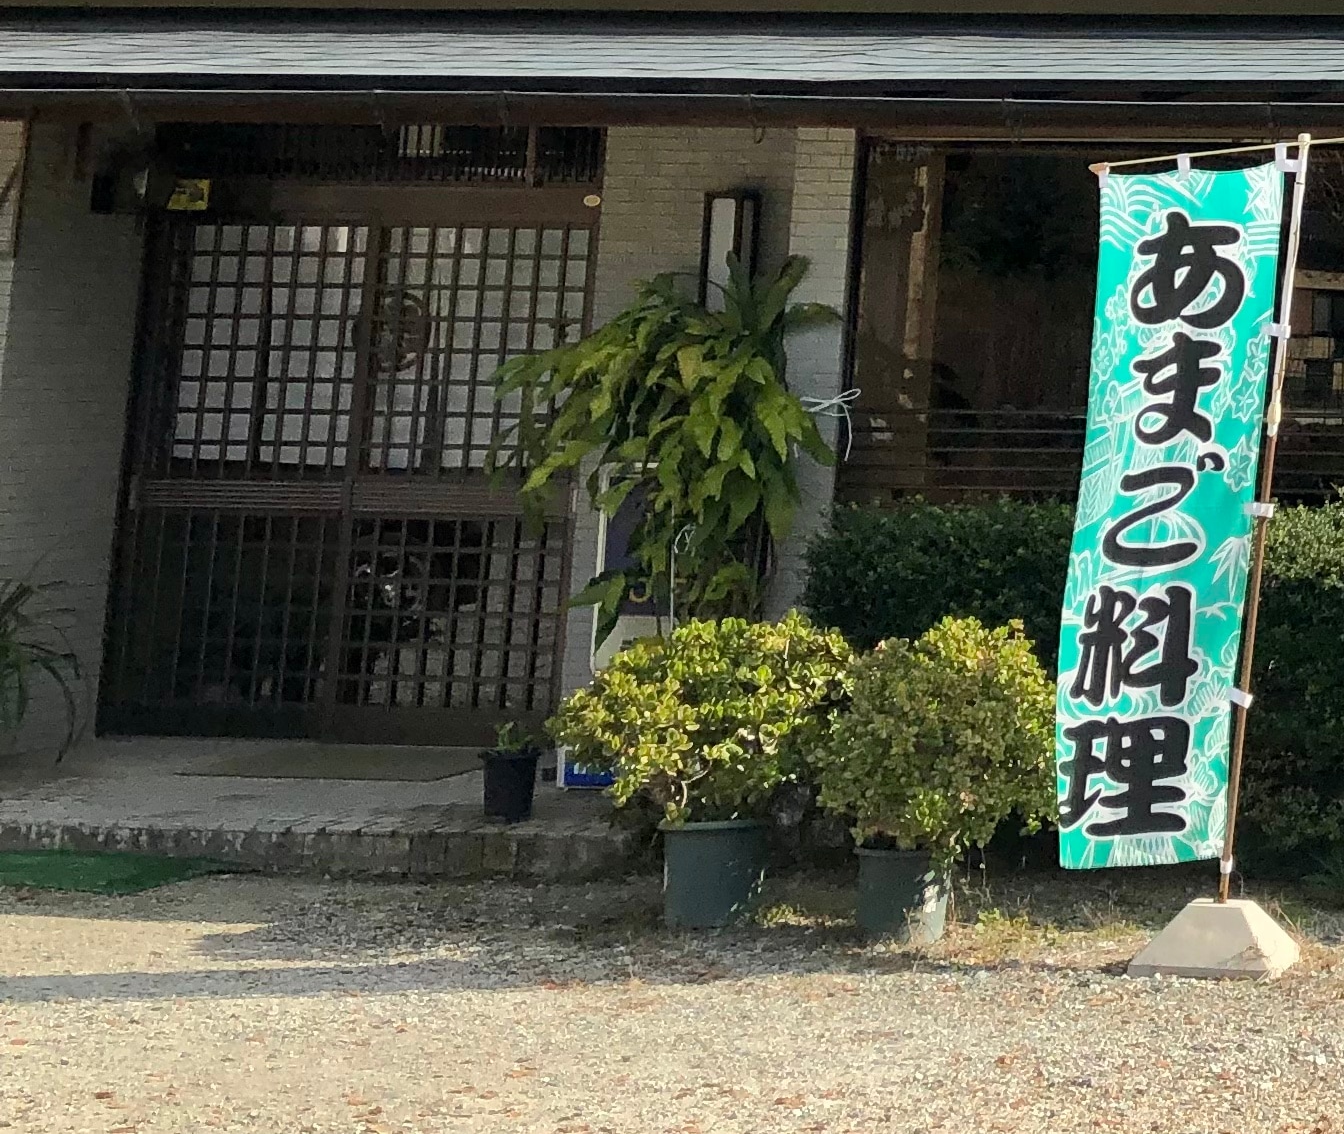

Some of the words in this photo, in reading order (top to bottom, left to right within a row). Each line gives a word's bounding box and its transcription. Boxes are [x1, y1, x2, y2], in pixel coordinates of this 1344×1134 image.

[1060, 213, 1245, 836] あまご料理
